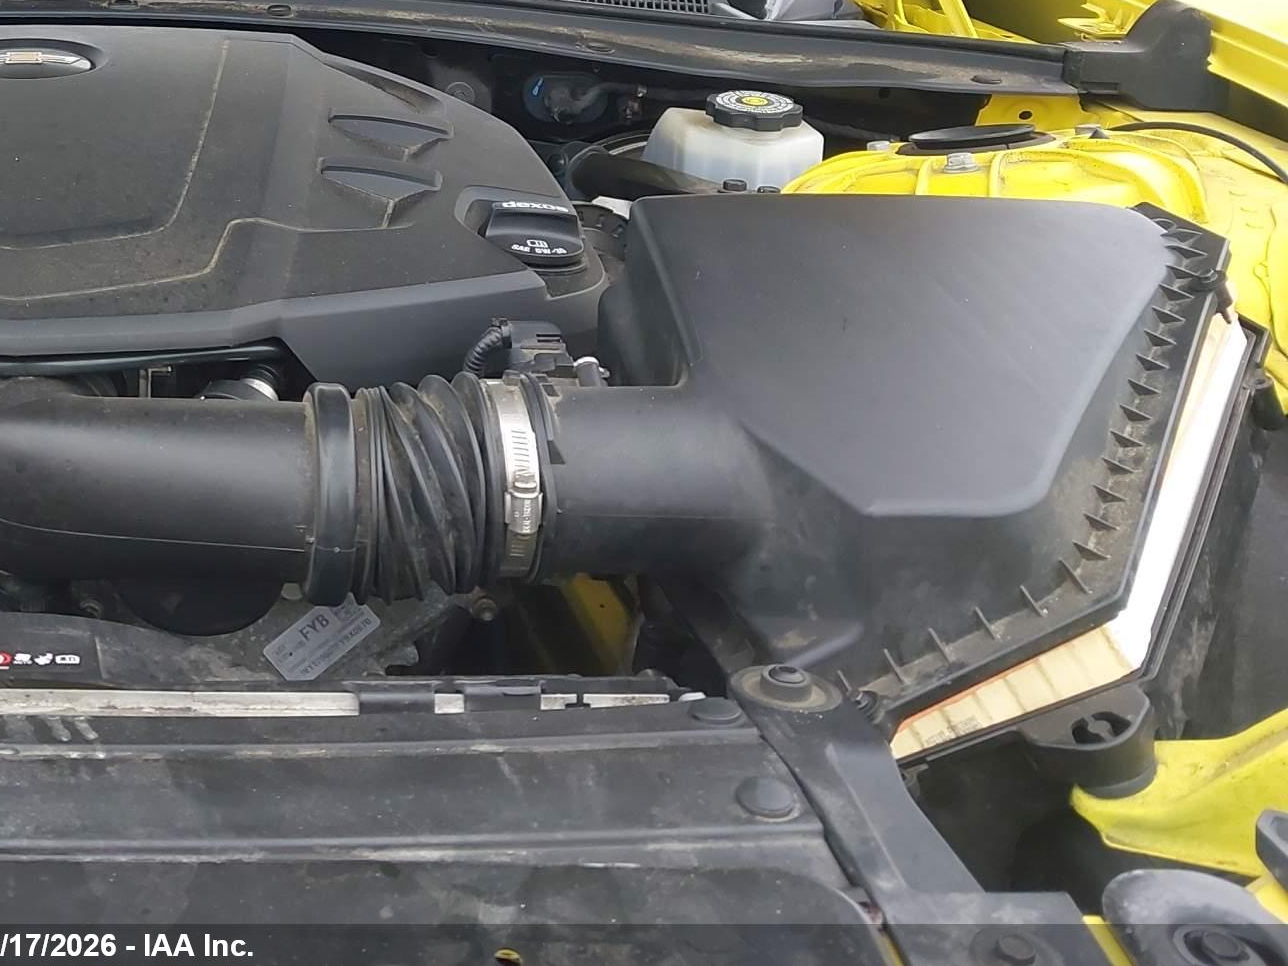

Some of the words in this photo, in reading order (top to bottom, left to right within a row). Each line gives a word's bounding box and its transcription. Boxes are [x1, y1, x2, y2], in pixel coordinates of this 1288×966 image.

[502, 201, 569, 212] dexos
[511, 244, 531, 253] SAE
[298, 614, 330, 641] FYB
